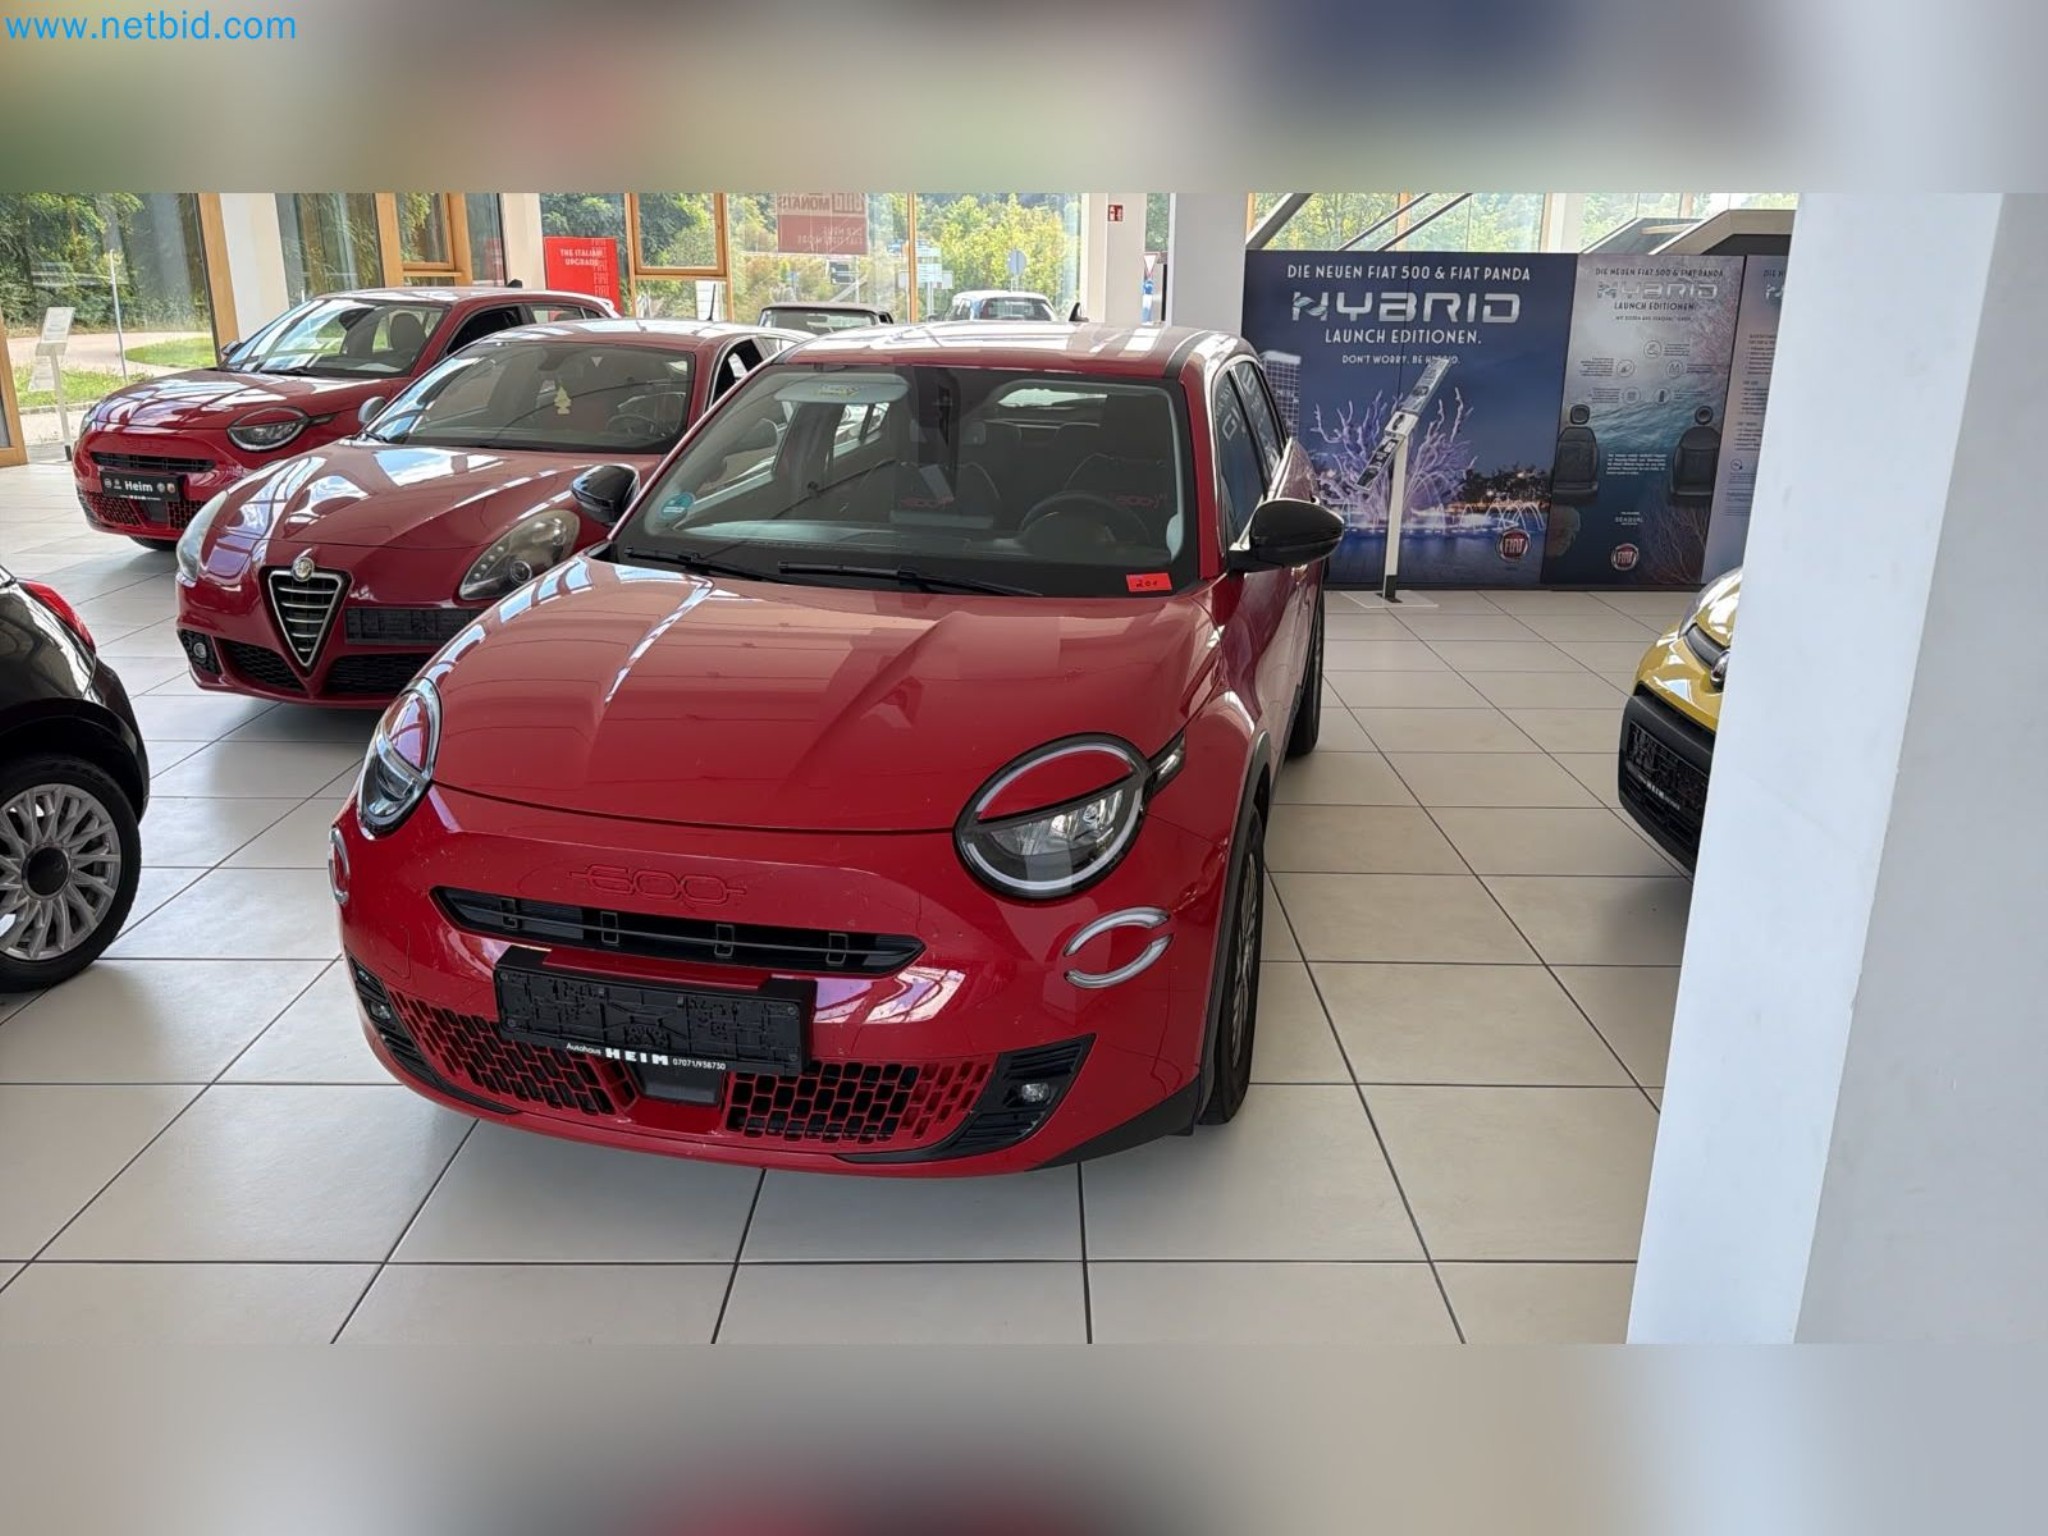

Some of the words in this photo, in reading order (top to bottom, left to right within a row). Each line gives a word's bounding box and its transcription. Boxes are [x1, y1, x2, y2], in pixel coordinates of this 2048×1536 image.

[1287, 264, 1311, 279] DIE
[1315, 265, 1363, 279] NEUEN
[1367, 265, 1397, 279] FIAT
[1401, 266, 1430, 280] 500
[1434, 266, 1445, 280] &
[1450, 266, 1479, 280] FIAT
[1484, 267, 1531, 281] PANDA
[1292, 291, 1521, 323] HYBRID
[1325, 329, 1386, 344] LAUNCH
[1391, 329, 1482, 345] EDITIONEN.
[124, 480, 153, 492] Heim
[1503, 538, 1525, 553] FIAT
[605, 1047, 669, 1066] HEIM
